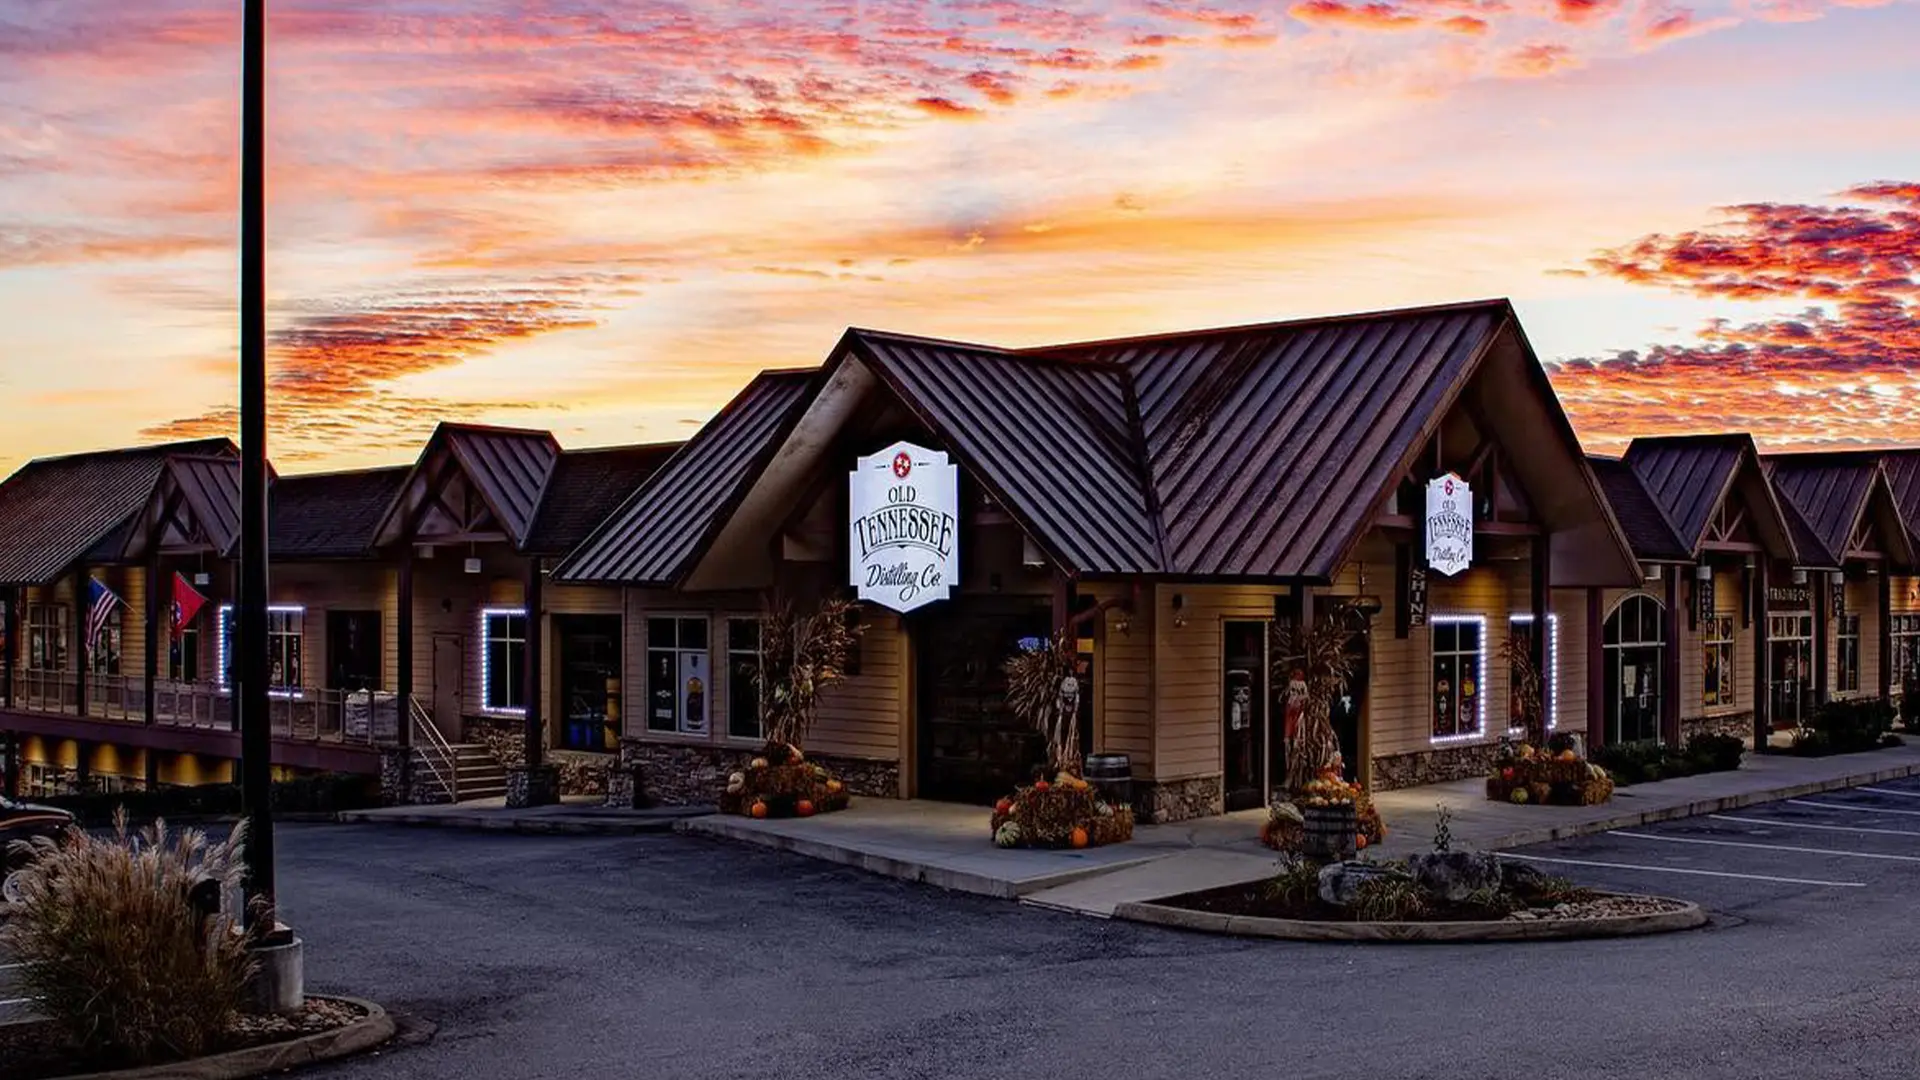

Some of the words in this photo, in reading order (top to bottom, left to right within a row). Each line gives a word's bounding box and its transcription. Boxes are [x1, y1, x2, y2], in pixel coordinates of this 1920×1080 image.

[888, 485, 916, 503] OLD
[853, 507, 954, 557] TENNESSEE
[1428, 515, 1472, 547] TENNESSEE
[866, 562, 920, 602] Distilling
[1410, 568, 1426, 625] SHINE
